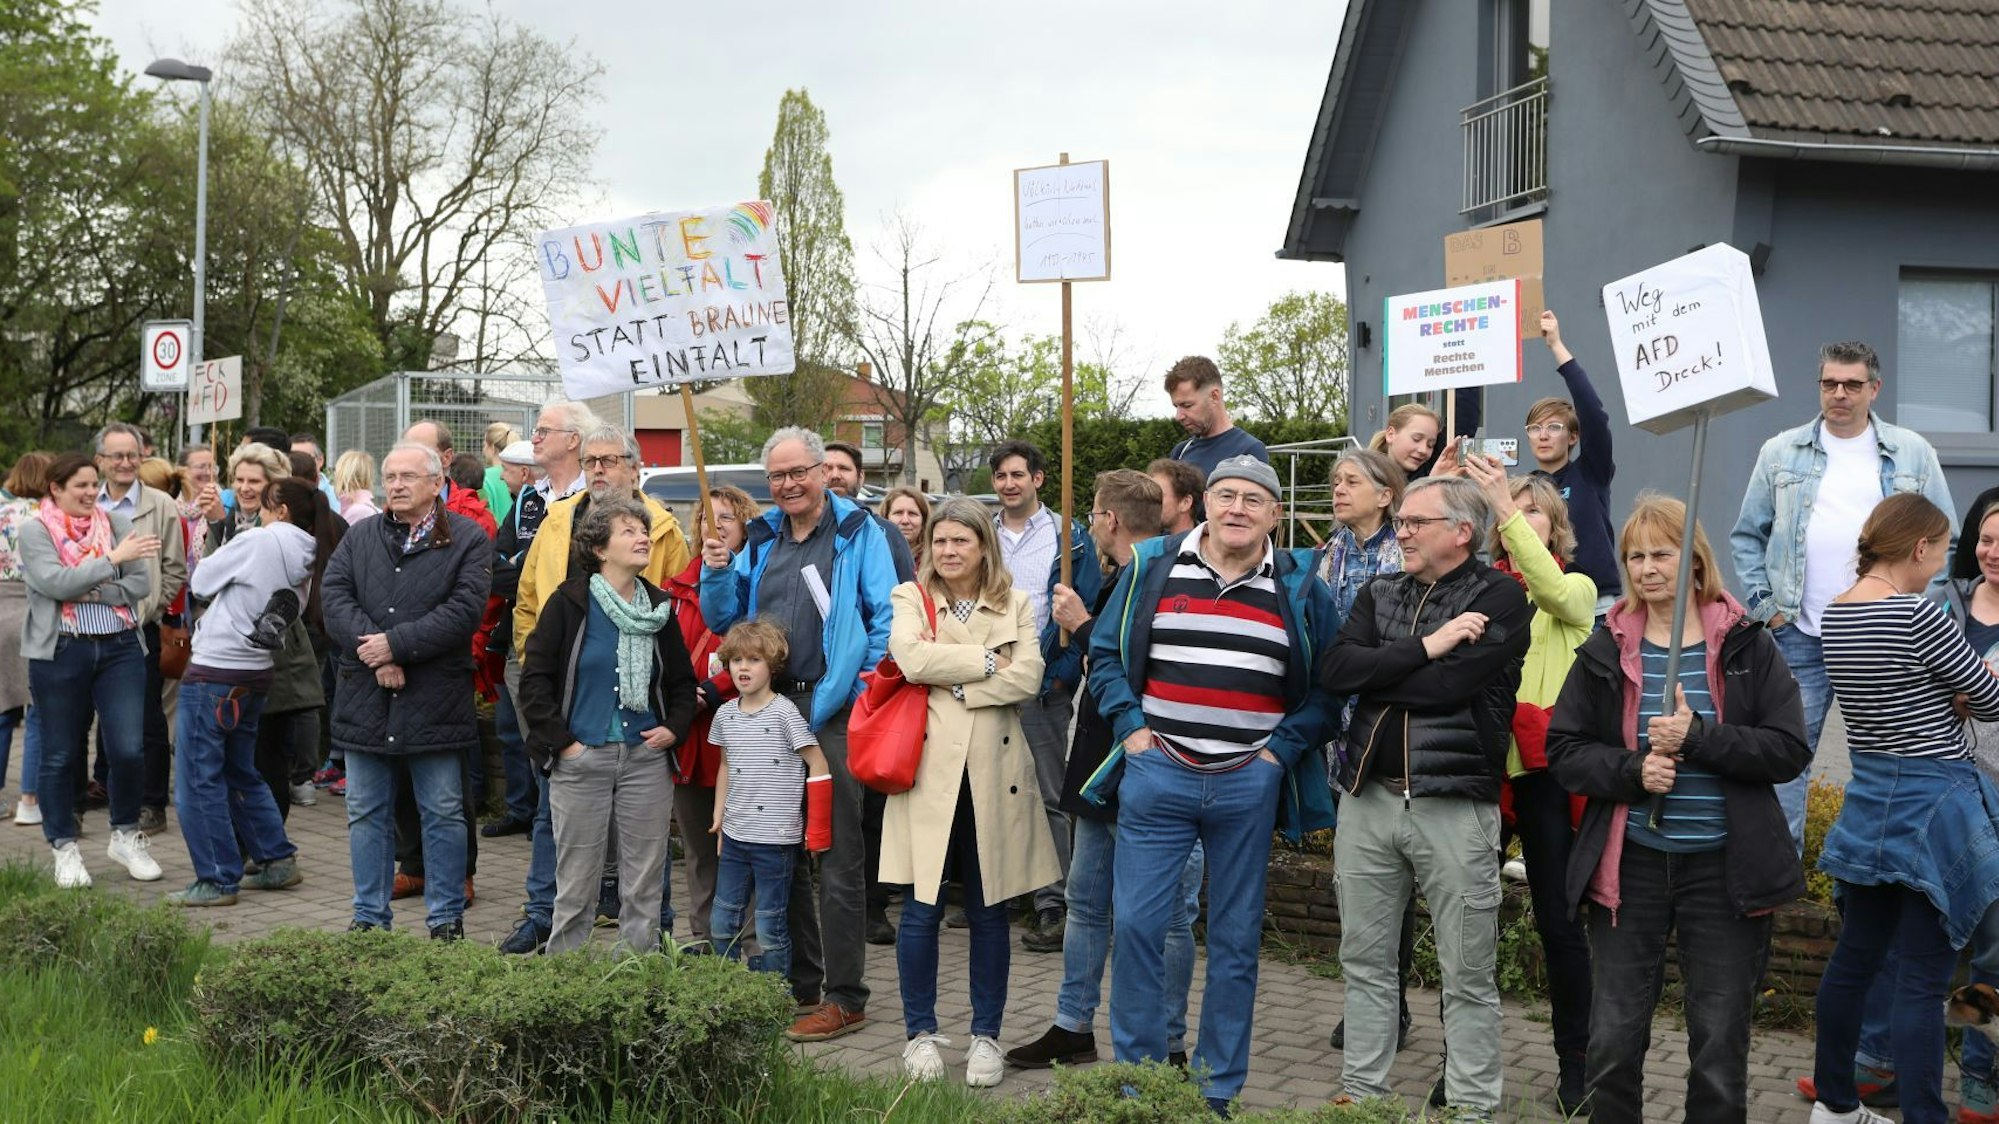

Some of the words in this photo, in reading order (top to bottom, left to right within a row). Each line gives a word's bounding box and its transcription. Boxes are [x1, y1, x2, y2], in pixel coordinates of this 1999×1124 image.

[543, 215, 713, 281] BUNTE
[1502, 228, 1522, 255] B
[594, 253, 767, 314] VIELFALT
[1616, 281, 1665, 315] Weg
[1402, 294, 1508, 321] MENSCHEN-
[1632, 313, 1657, 334] mit
[1672, 300, 1701, 317] dem
[571, 313, 668, 363] STATT
[687, 300, 786, 338] BRAUNE
[1420, 315, 1489, 337] RECHTE
[159, 342, 176, 360] 30
[1433, 350, 1476, 365] Rechte
[1442, 339, 1465, 349] statt
[1636, 335, 1679, 370] AFD
[195, 362, 226, 386] FCK
[629, 335, 768, 384] EINFALT
[1424, 362, 1485, 378] Menschen
[1654, 341, 1723, 393] Dreck!
[156, 372, 177, 383] ZONE
[192, 381, 228, 413] AFD
